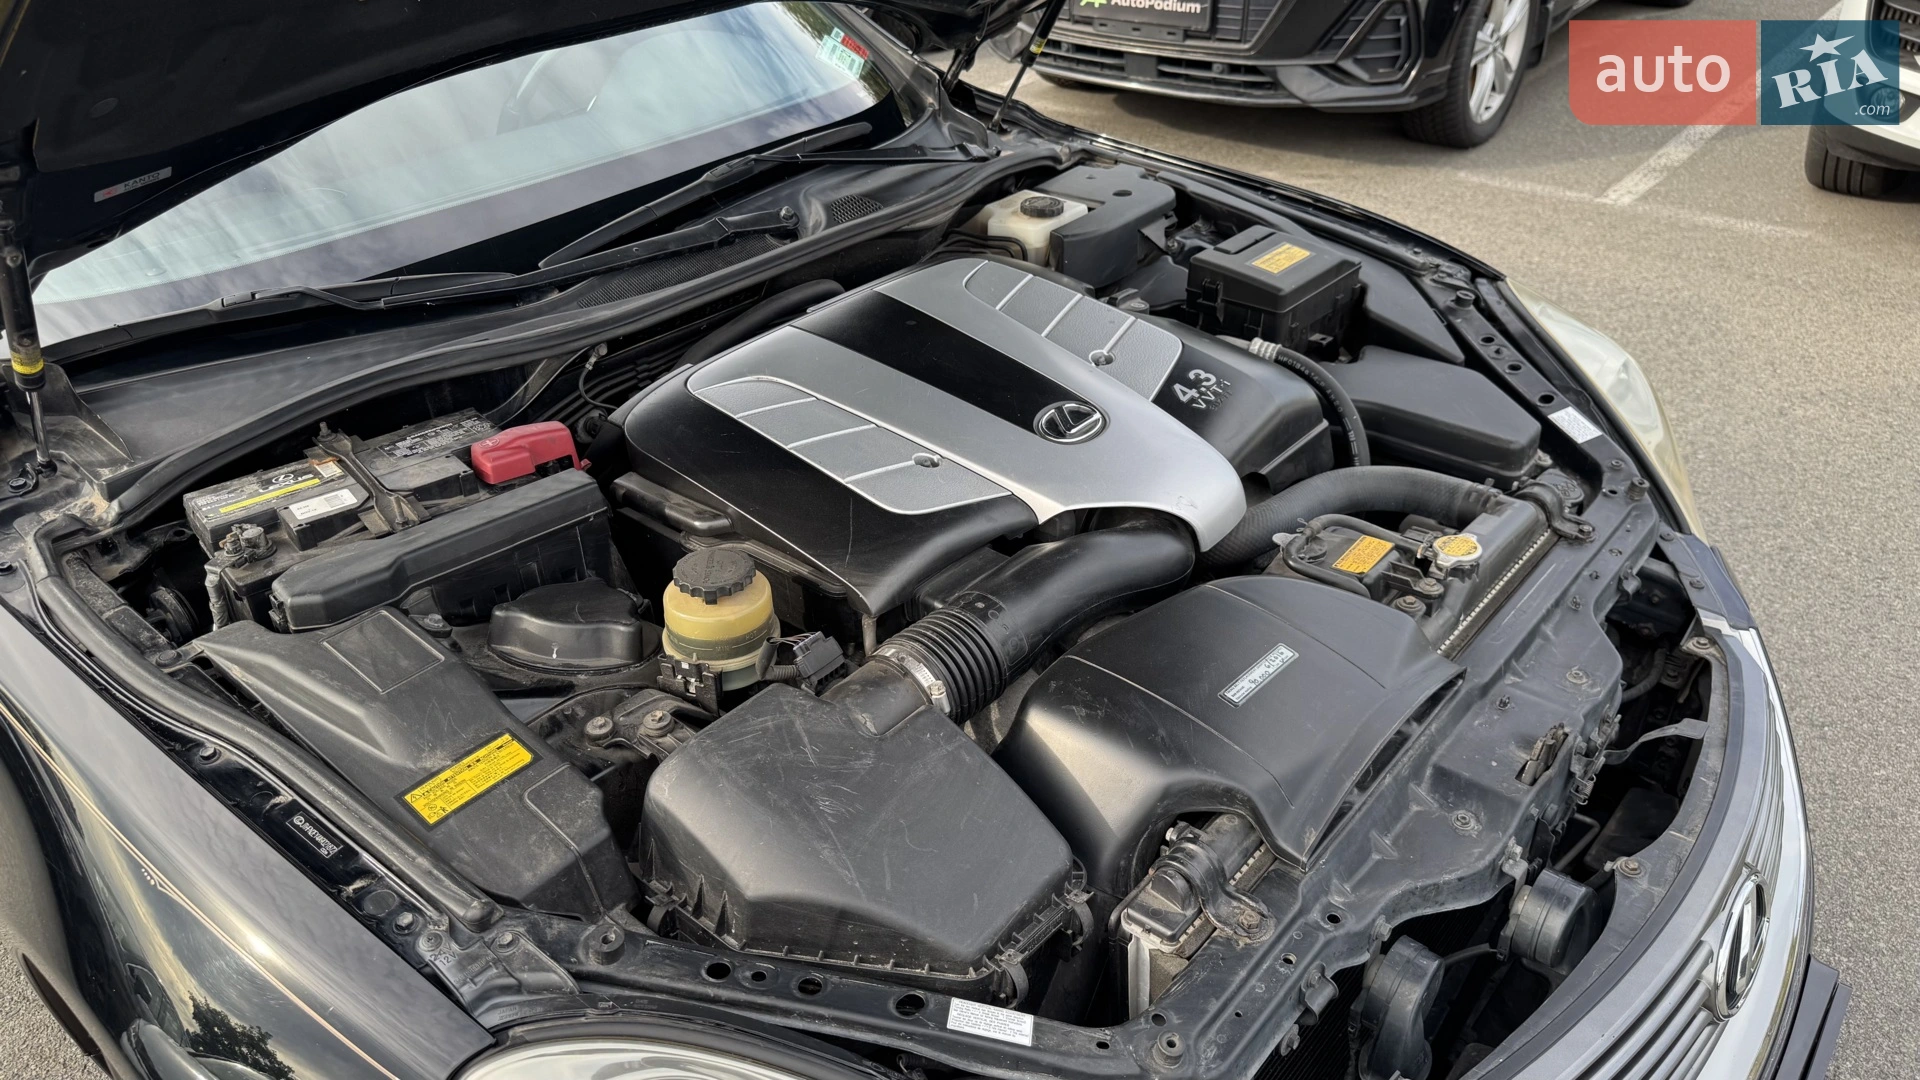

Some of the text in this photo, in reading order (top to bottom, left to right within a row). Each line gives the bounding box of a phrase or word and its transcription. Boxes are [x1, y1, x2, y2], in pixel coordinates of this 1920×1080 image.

[124, 172, 160, 188] KANTO
[1173, 369, 1217, 404] 4.3
[1192, 379, 1231, 409] VVT-i
